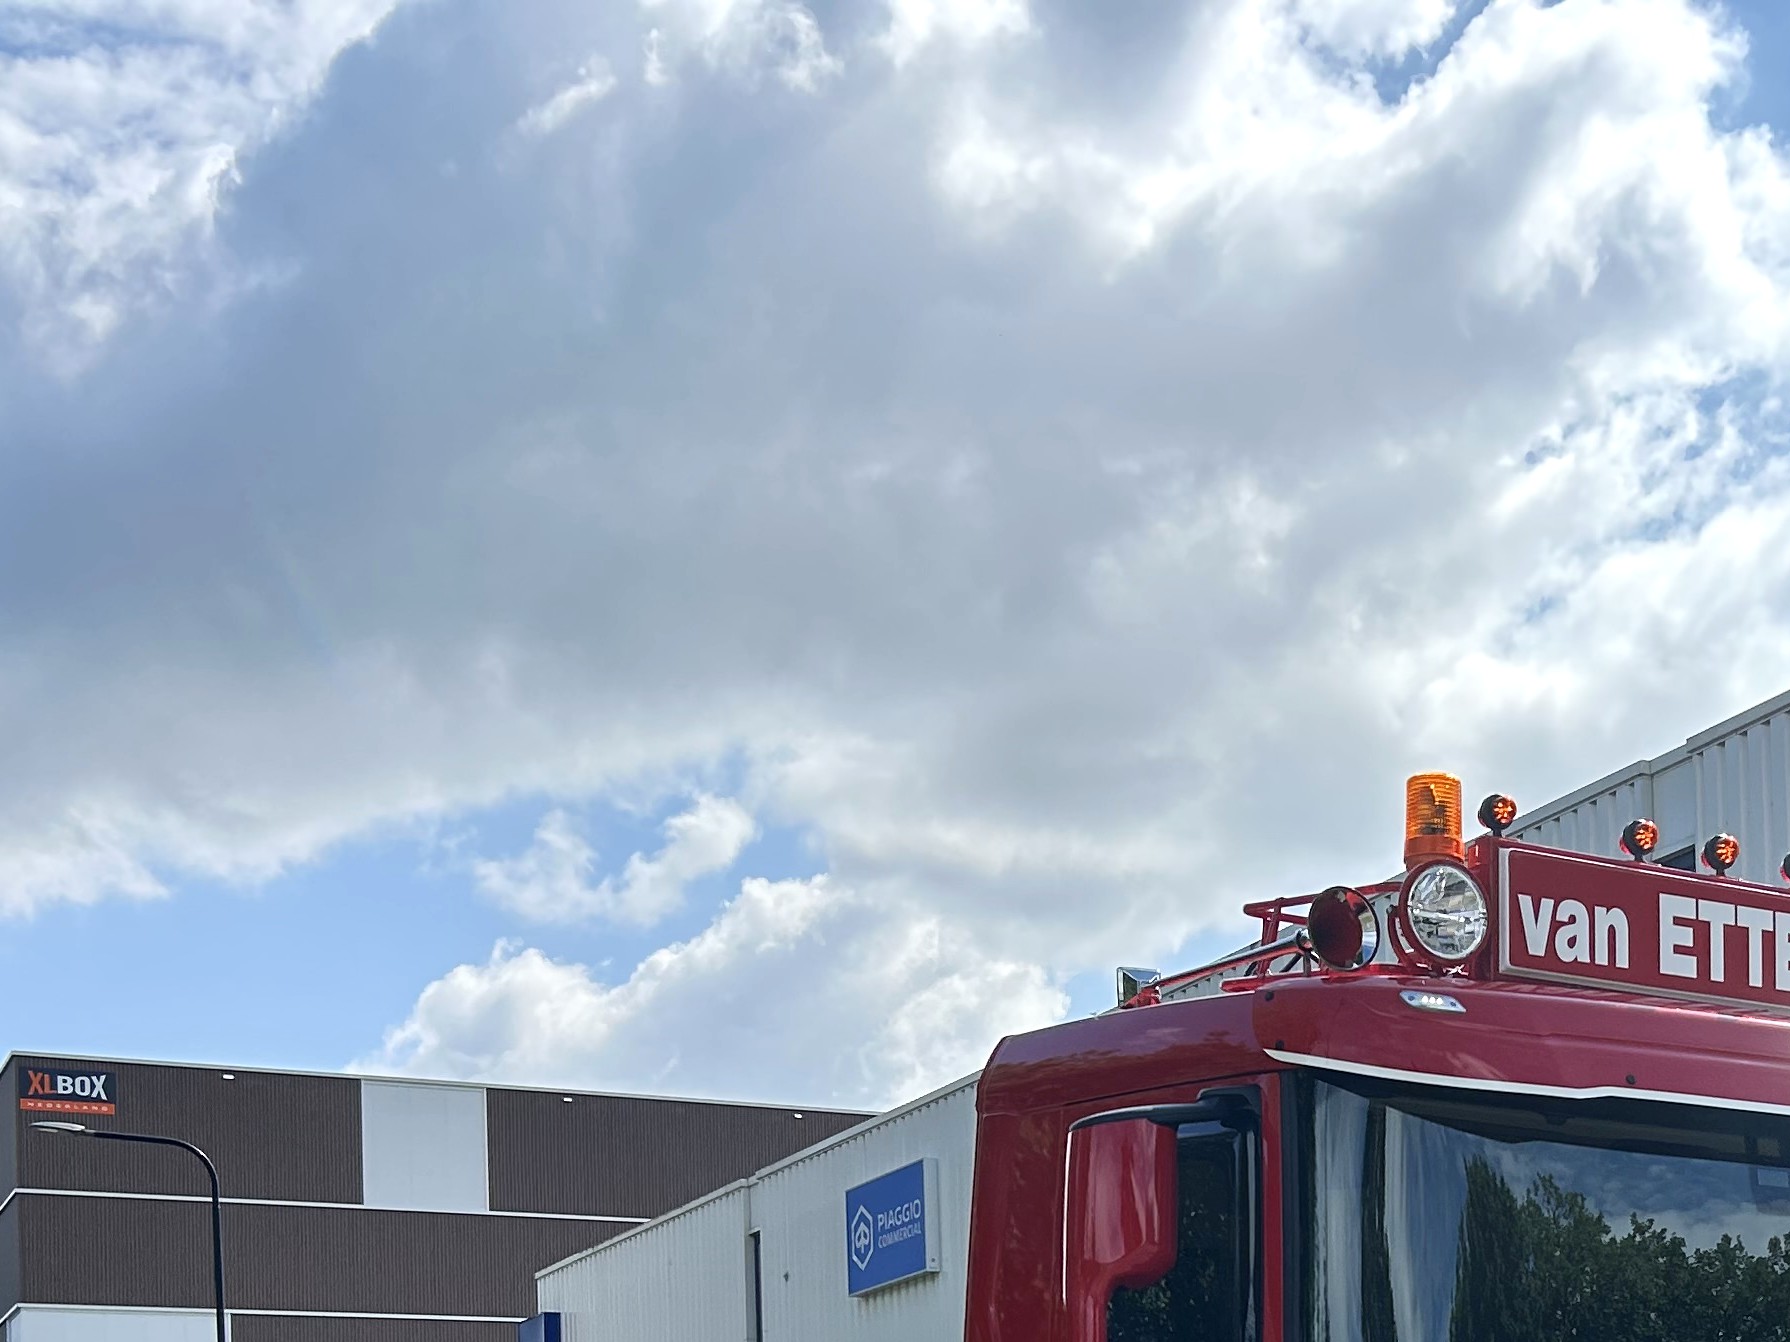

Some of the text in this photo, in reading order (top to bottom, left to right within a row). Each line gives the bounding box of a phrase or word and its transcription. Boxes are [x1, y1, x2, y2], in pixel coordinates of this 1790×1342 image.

[1517, 892, 1631, 970] van
[877, 1198, 922, 1232] PIAGGIO
[878, 1221, 922, 1249] COMMERCIAL
